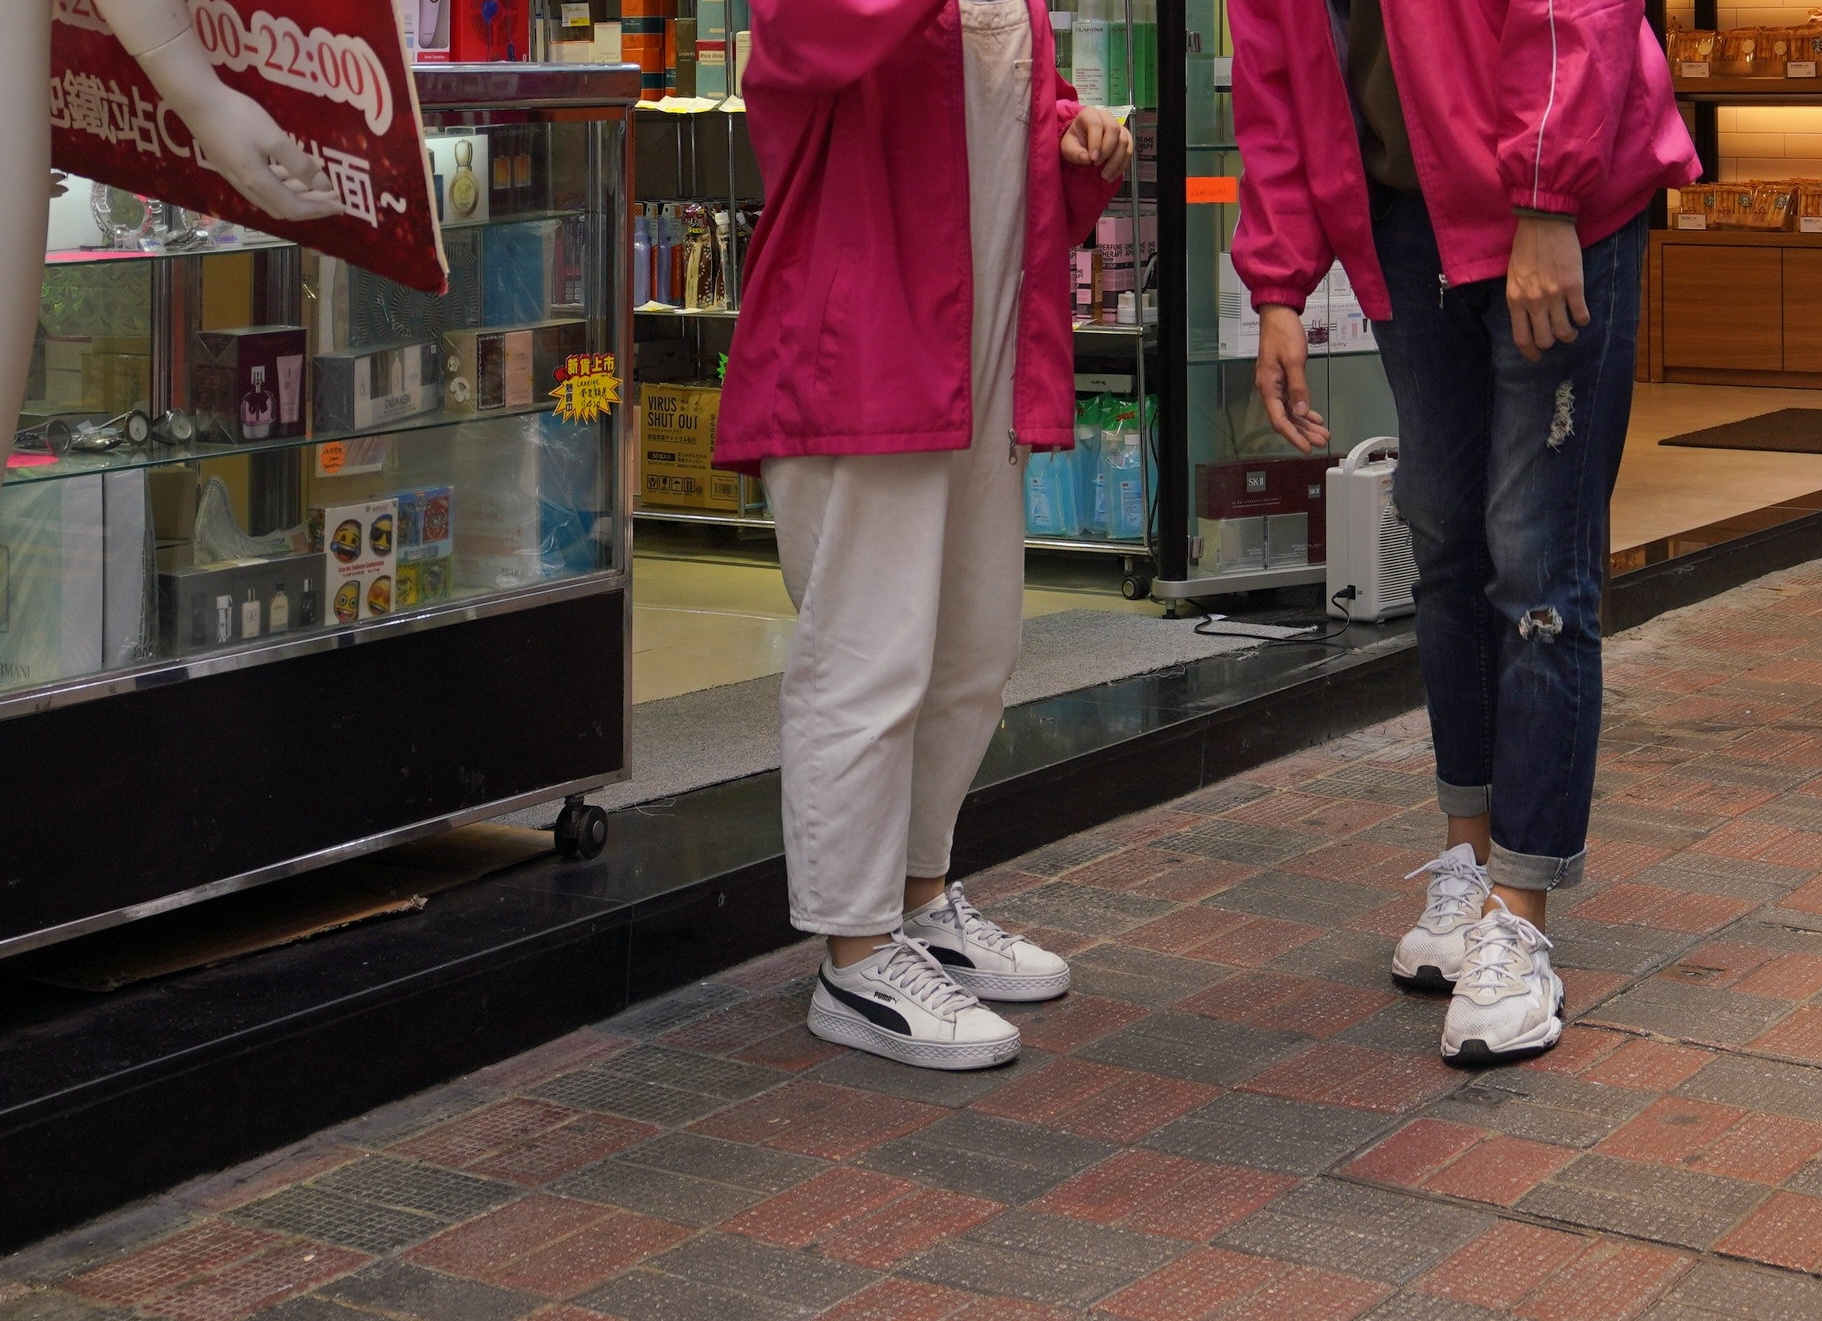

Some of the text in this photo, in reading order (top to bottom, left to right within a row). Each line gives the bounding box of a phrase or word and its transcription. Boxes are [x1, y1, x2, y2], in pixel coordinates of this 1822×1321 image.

[648, 396, 677, 412] VIRUS
[648, 412, 698, 430] SHUT OUT
